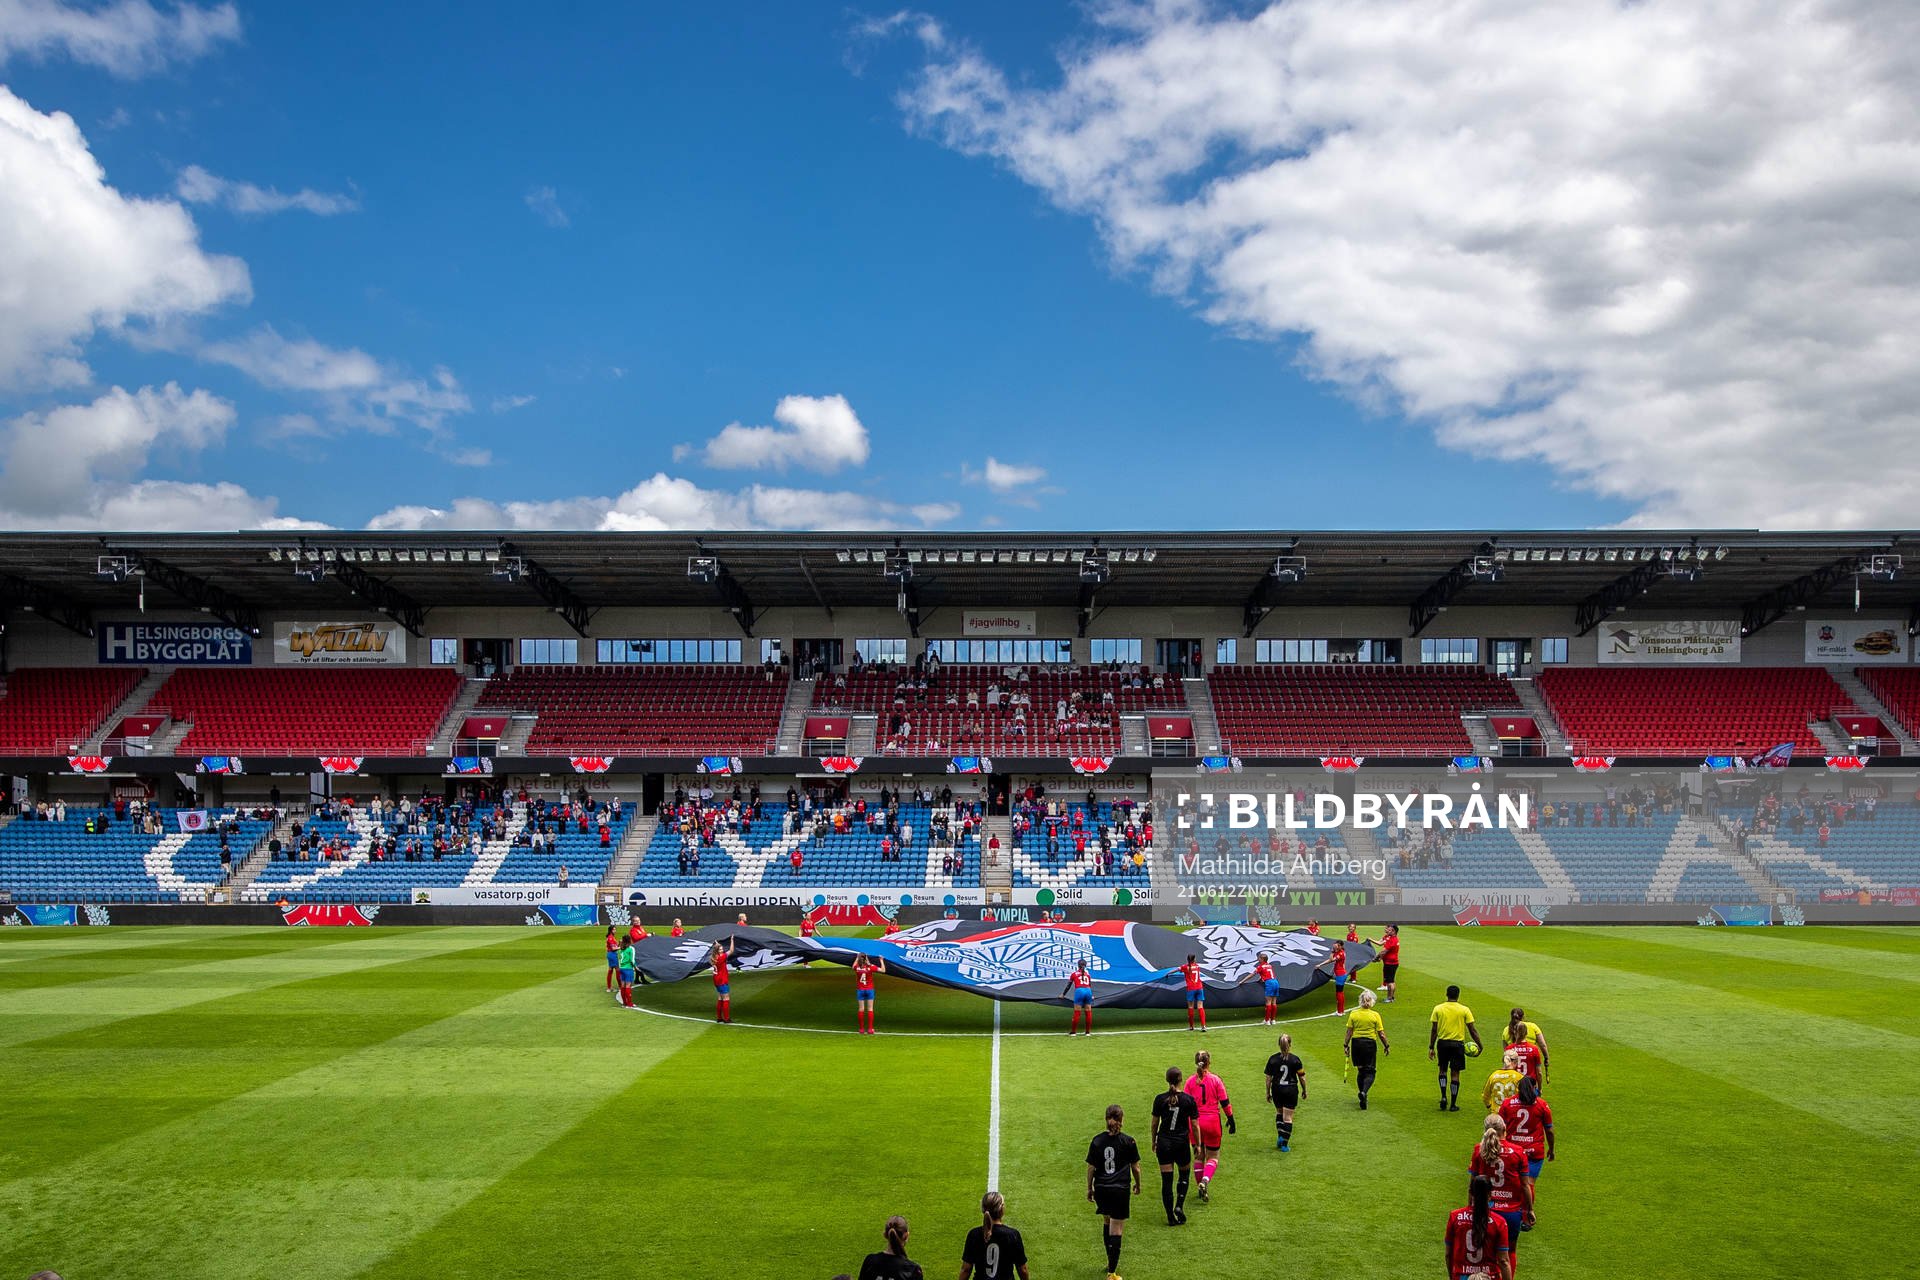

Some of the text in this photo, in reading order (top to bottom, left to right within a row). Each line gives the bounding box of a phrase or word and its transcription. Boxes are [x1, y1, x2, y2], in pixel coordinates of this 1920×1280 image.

[969, 618, 1020, 628] #jagvillhbg
[106, 626, 243, 659] HELSINGBORGS
[290, 624, 389, 656] WALLIN
[1638, 635, 1732, 646] Jönssons Plåtslageri
[136, 640, 244, 660] BYGGPLÅT
[1653, 646, 1708, 656] Helsingborg
[512, 776, 610, 790] Det är kärlek
[716, 778, 764, 792] syster
[858, 776, 922, 790] och bror
[1048, 776, 1064, 790] är
[1068, 776, 1135, 790] bultande
[1204, 776, 1290, 792] hjärtan och
[1362, 776, 1404, 790] slitna
[474, 889, 550, 902] vasatorp.golf
[1056, 888, 1082, 898] Solid
[1134, 888, 1160, 898] Solid
[980, 908, 1029, 922] OYMPIA
[860, 973, 866, 986] 4
[1192, 971, 1198, 982] 7
[1516, 1056, 1527, 1075] 5
[1280, 1065, 1288, 1085] 2
[1169, 1106, 1180, 1130] 7
[1516, 1108, 1529, 1133] 2
[1104, 1146, 1115, 1174] 8
[1490, 1158, 1504, 1187] 3
[1466, 1228, 1483, 1263] 9
[985, 1242, 1000, 1278] 9
